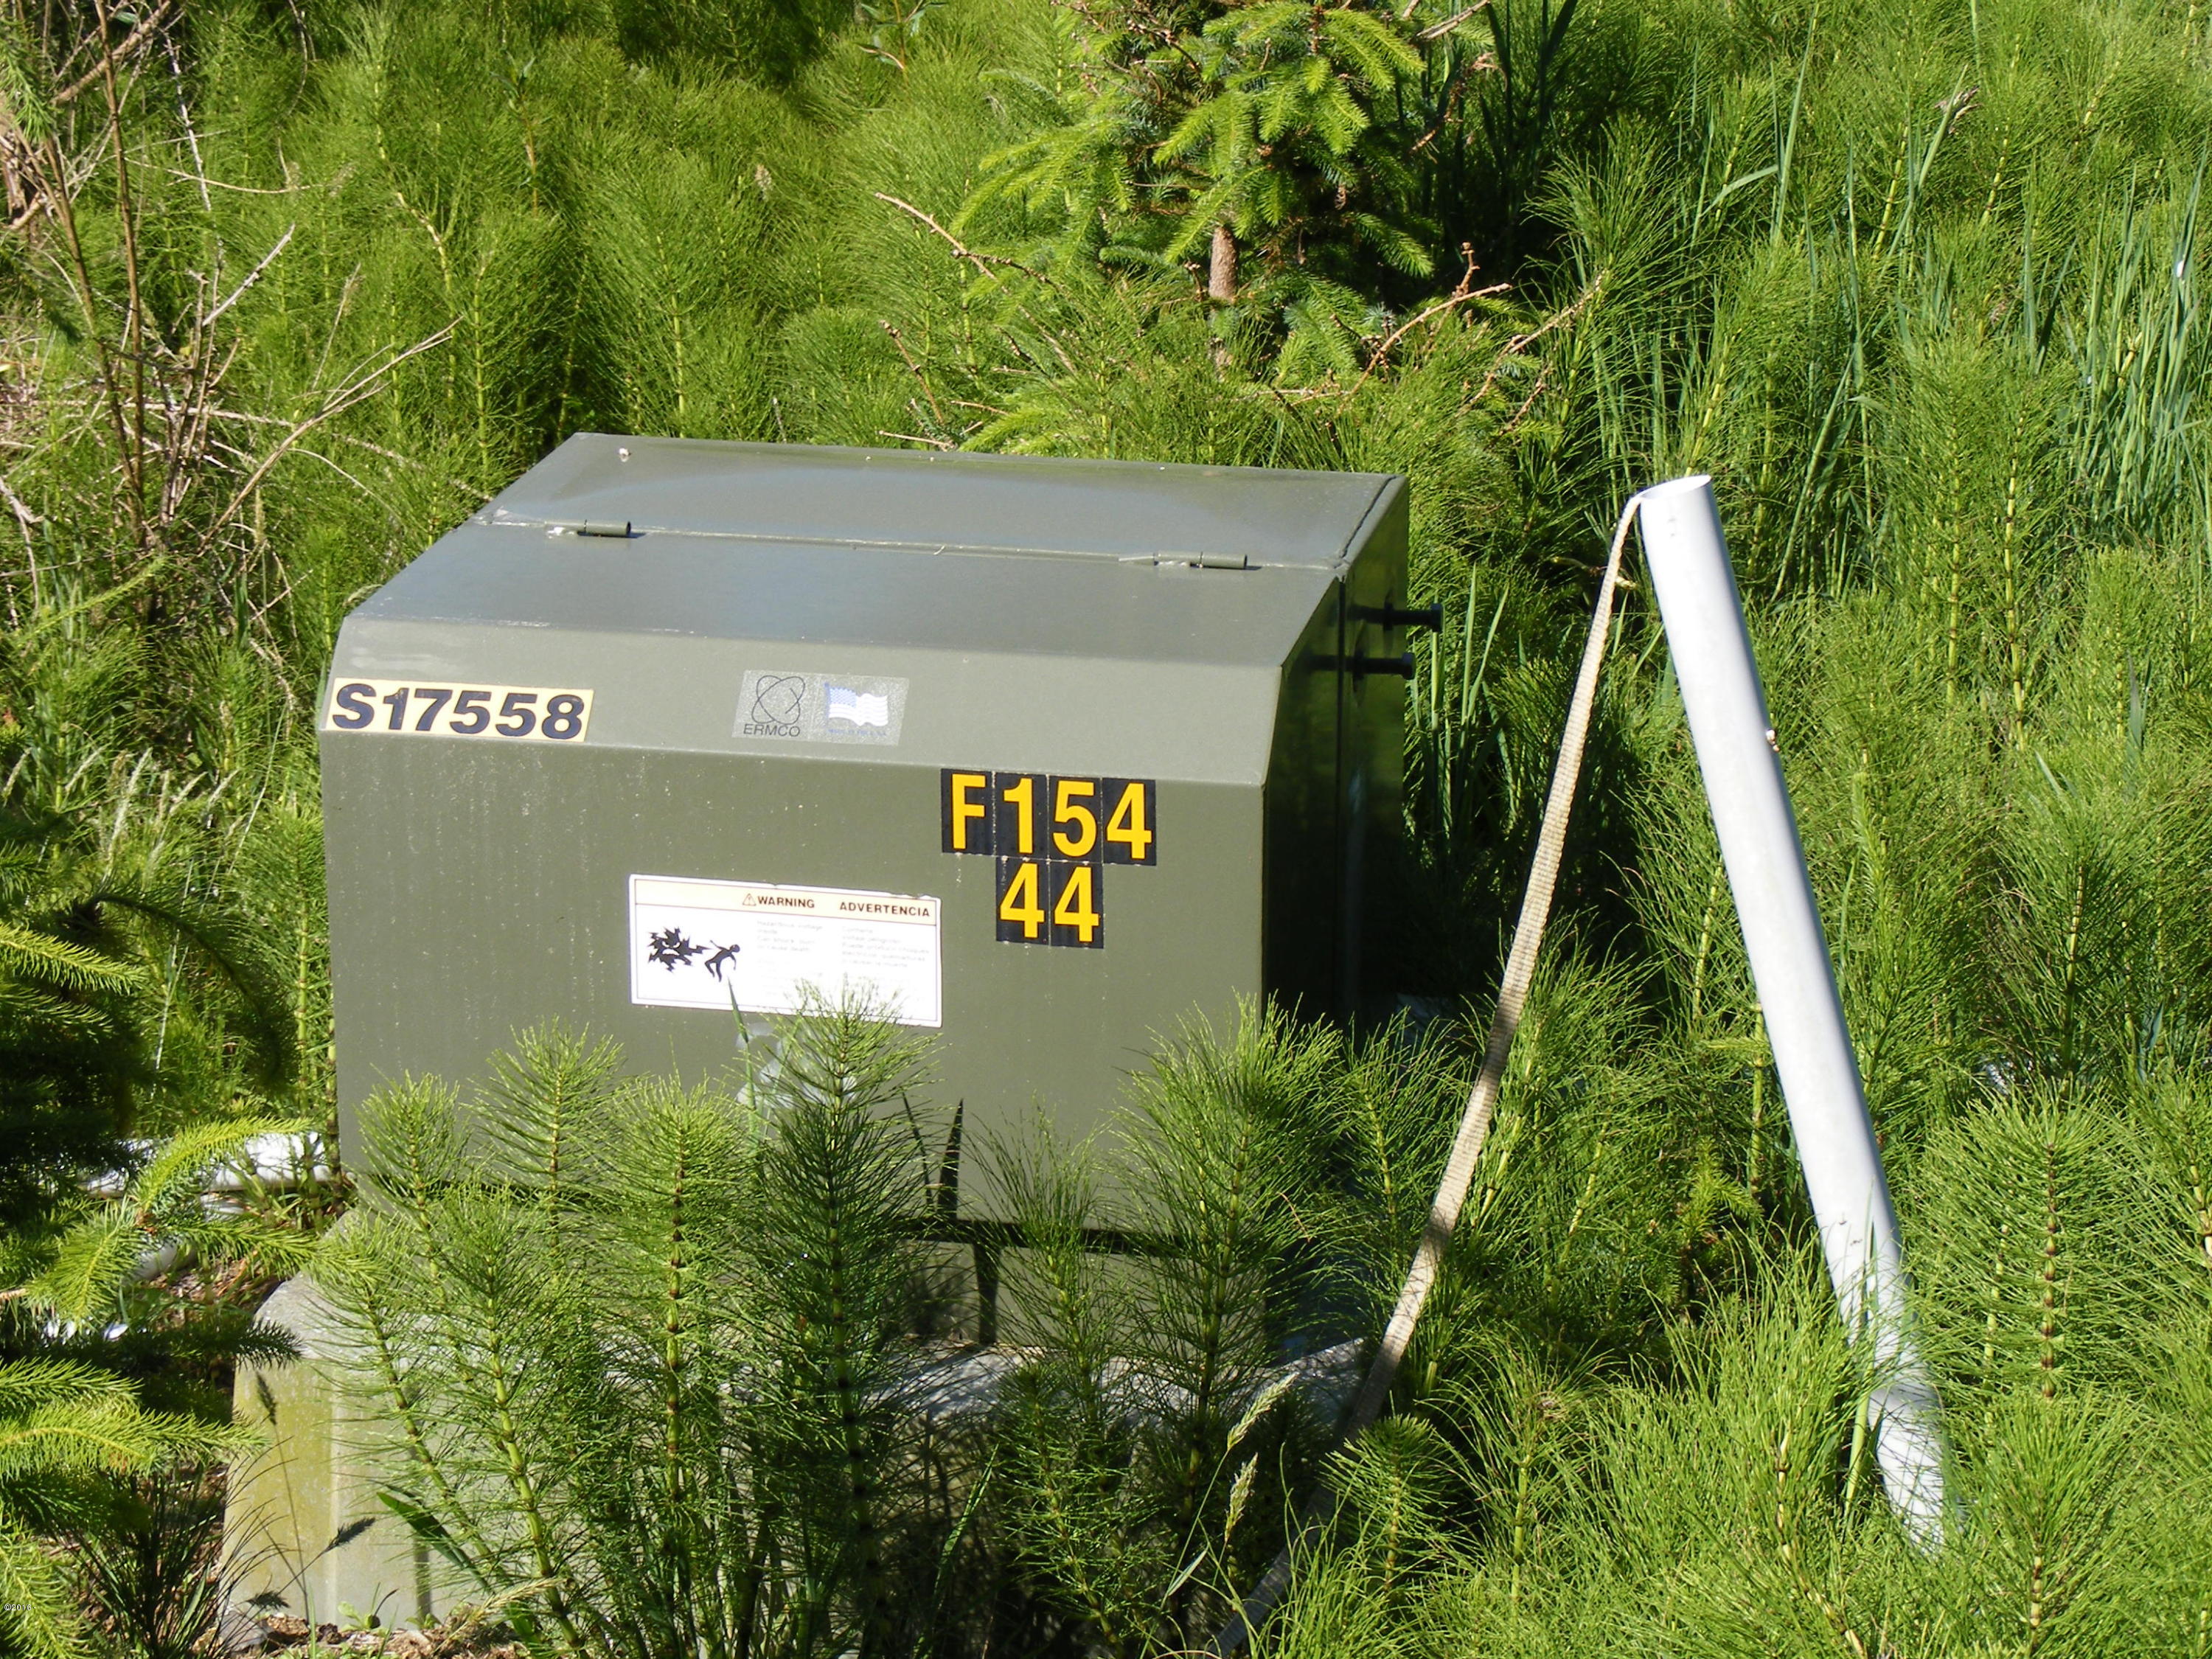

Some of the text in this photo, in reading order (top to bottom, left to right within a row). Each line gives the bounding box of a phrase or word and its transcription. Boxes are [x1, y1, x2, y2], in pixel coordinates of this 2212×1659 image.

[332, 683, 585, 740] S17558
[742, 723, 801, 737] ERMCO
[757, 895, 815, 909] WARNING
[840, 901, 931, 918] ADVERTENCIA
[999, 862, 1099, 943] 44
